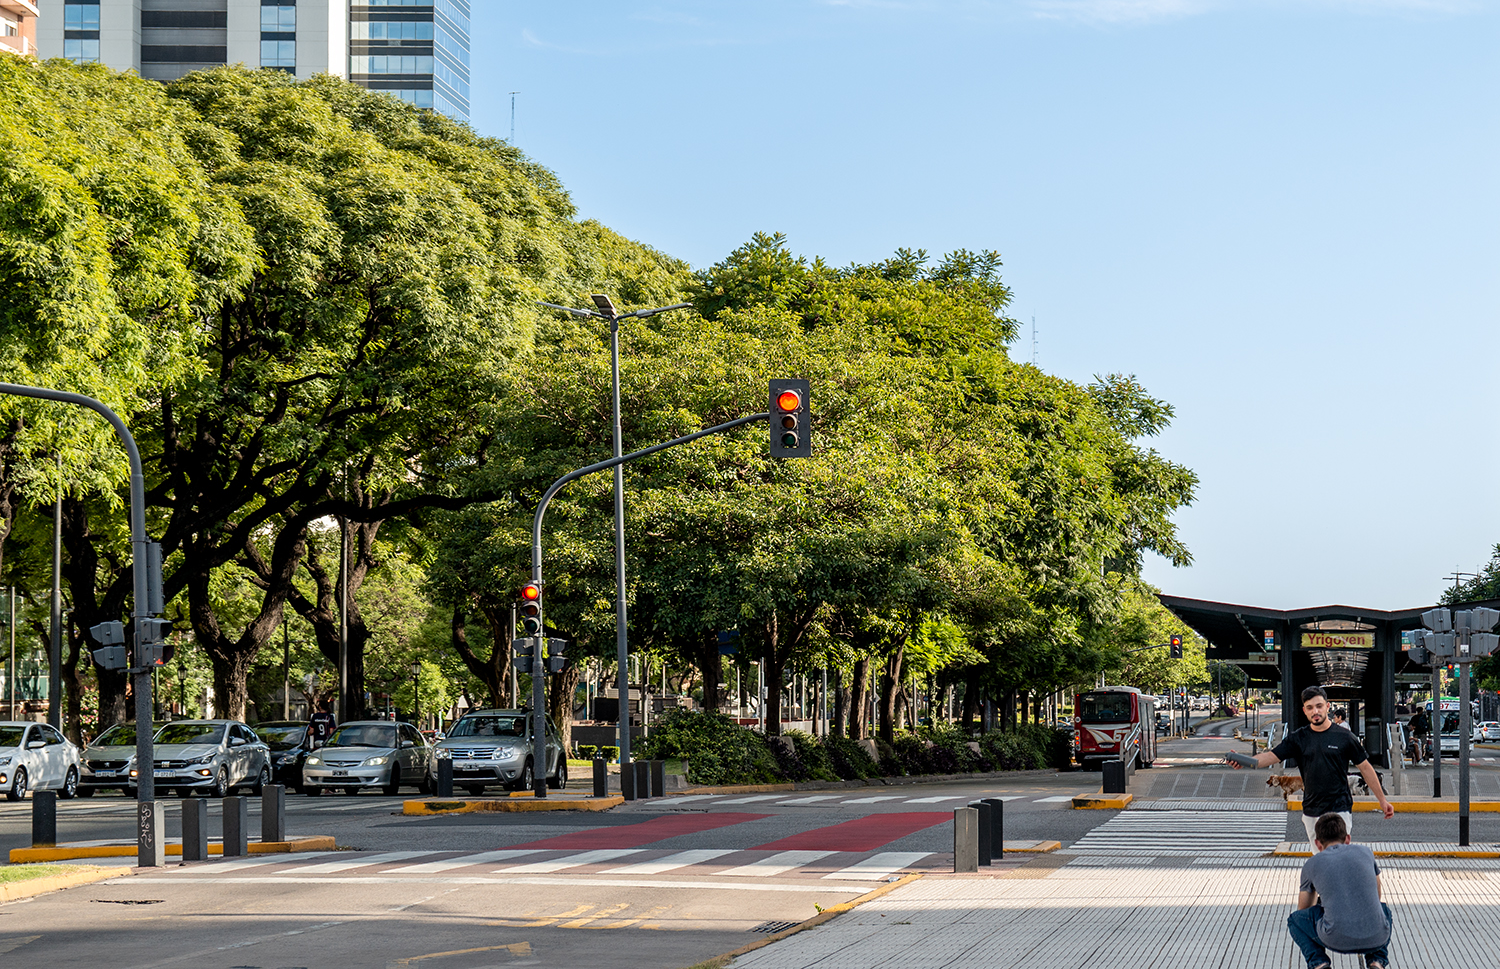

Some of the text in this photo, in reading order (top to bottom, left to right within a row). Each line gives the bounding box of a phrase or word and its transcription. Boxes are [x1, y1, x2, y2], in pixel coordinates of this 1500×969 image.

[1307, 633, 1366, 648] Yrigoyen
[318, 723, 326, 736] 9
[1113, 729, 1131, 743] 67
